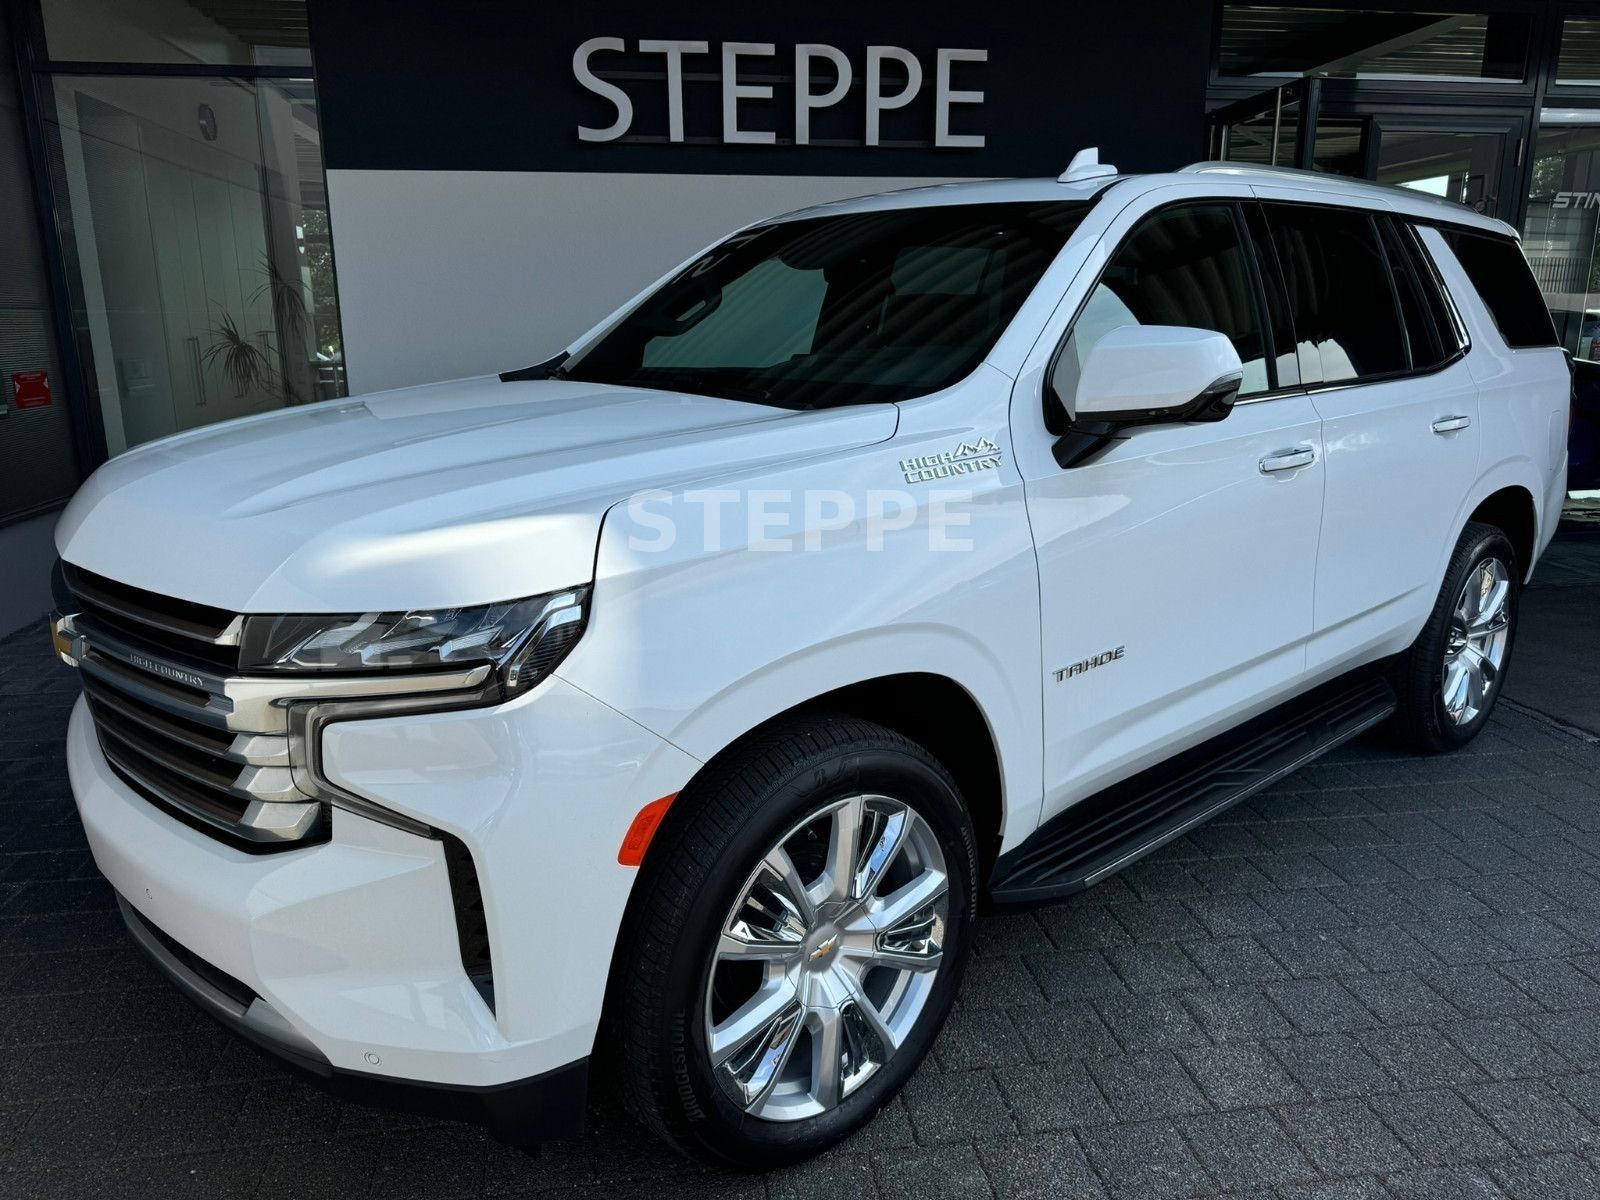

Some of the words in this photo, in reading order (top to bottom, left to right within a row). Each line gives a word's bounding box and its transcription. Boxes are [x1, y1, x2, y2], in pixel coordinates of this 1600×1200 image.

[572, 36, 989, 148] STEPPE
[899, 452, 954, 472] HIGH
[904, 456, 1002, 484] COUNTRY
[1052, 645, 1125, 682] TAHOE
